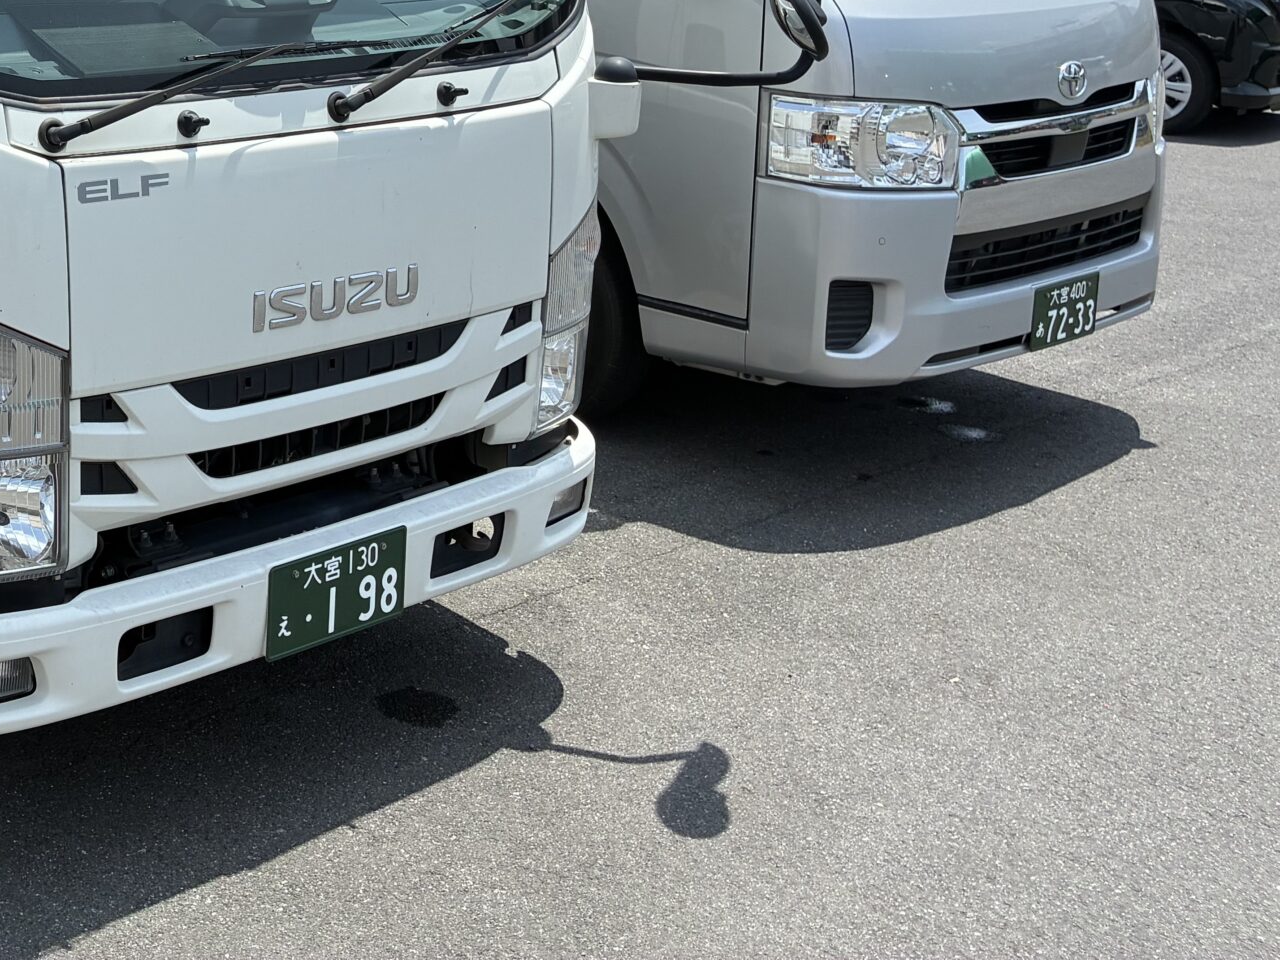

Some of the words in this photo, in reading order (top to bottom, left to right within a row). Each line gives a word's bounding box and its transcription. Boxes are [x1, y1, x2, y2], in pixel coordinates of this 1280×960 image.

[77, 172, 169, 204] ELF
[252, 263, 419, 334] ISUZU
[1050, 286, 1070, 306] 大宮
[1070, 280, 1087, 300] 400
[1035, 321, 1045, 338] あ
[1046, 299, 1095, 343] 72-33
[303, 555, 343, 589] 大宮
[349, 542, 379, 574] 130
[277, 616, 292, 637] え
